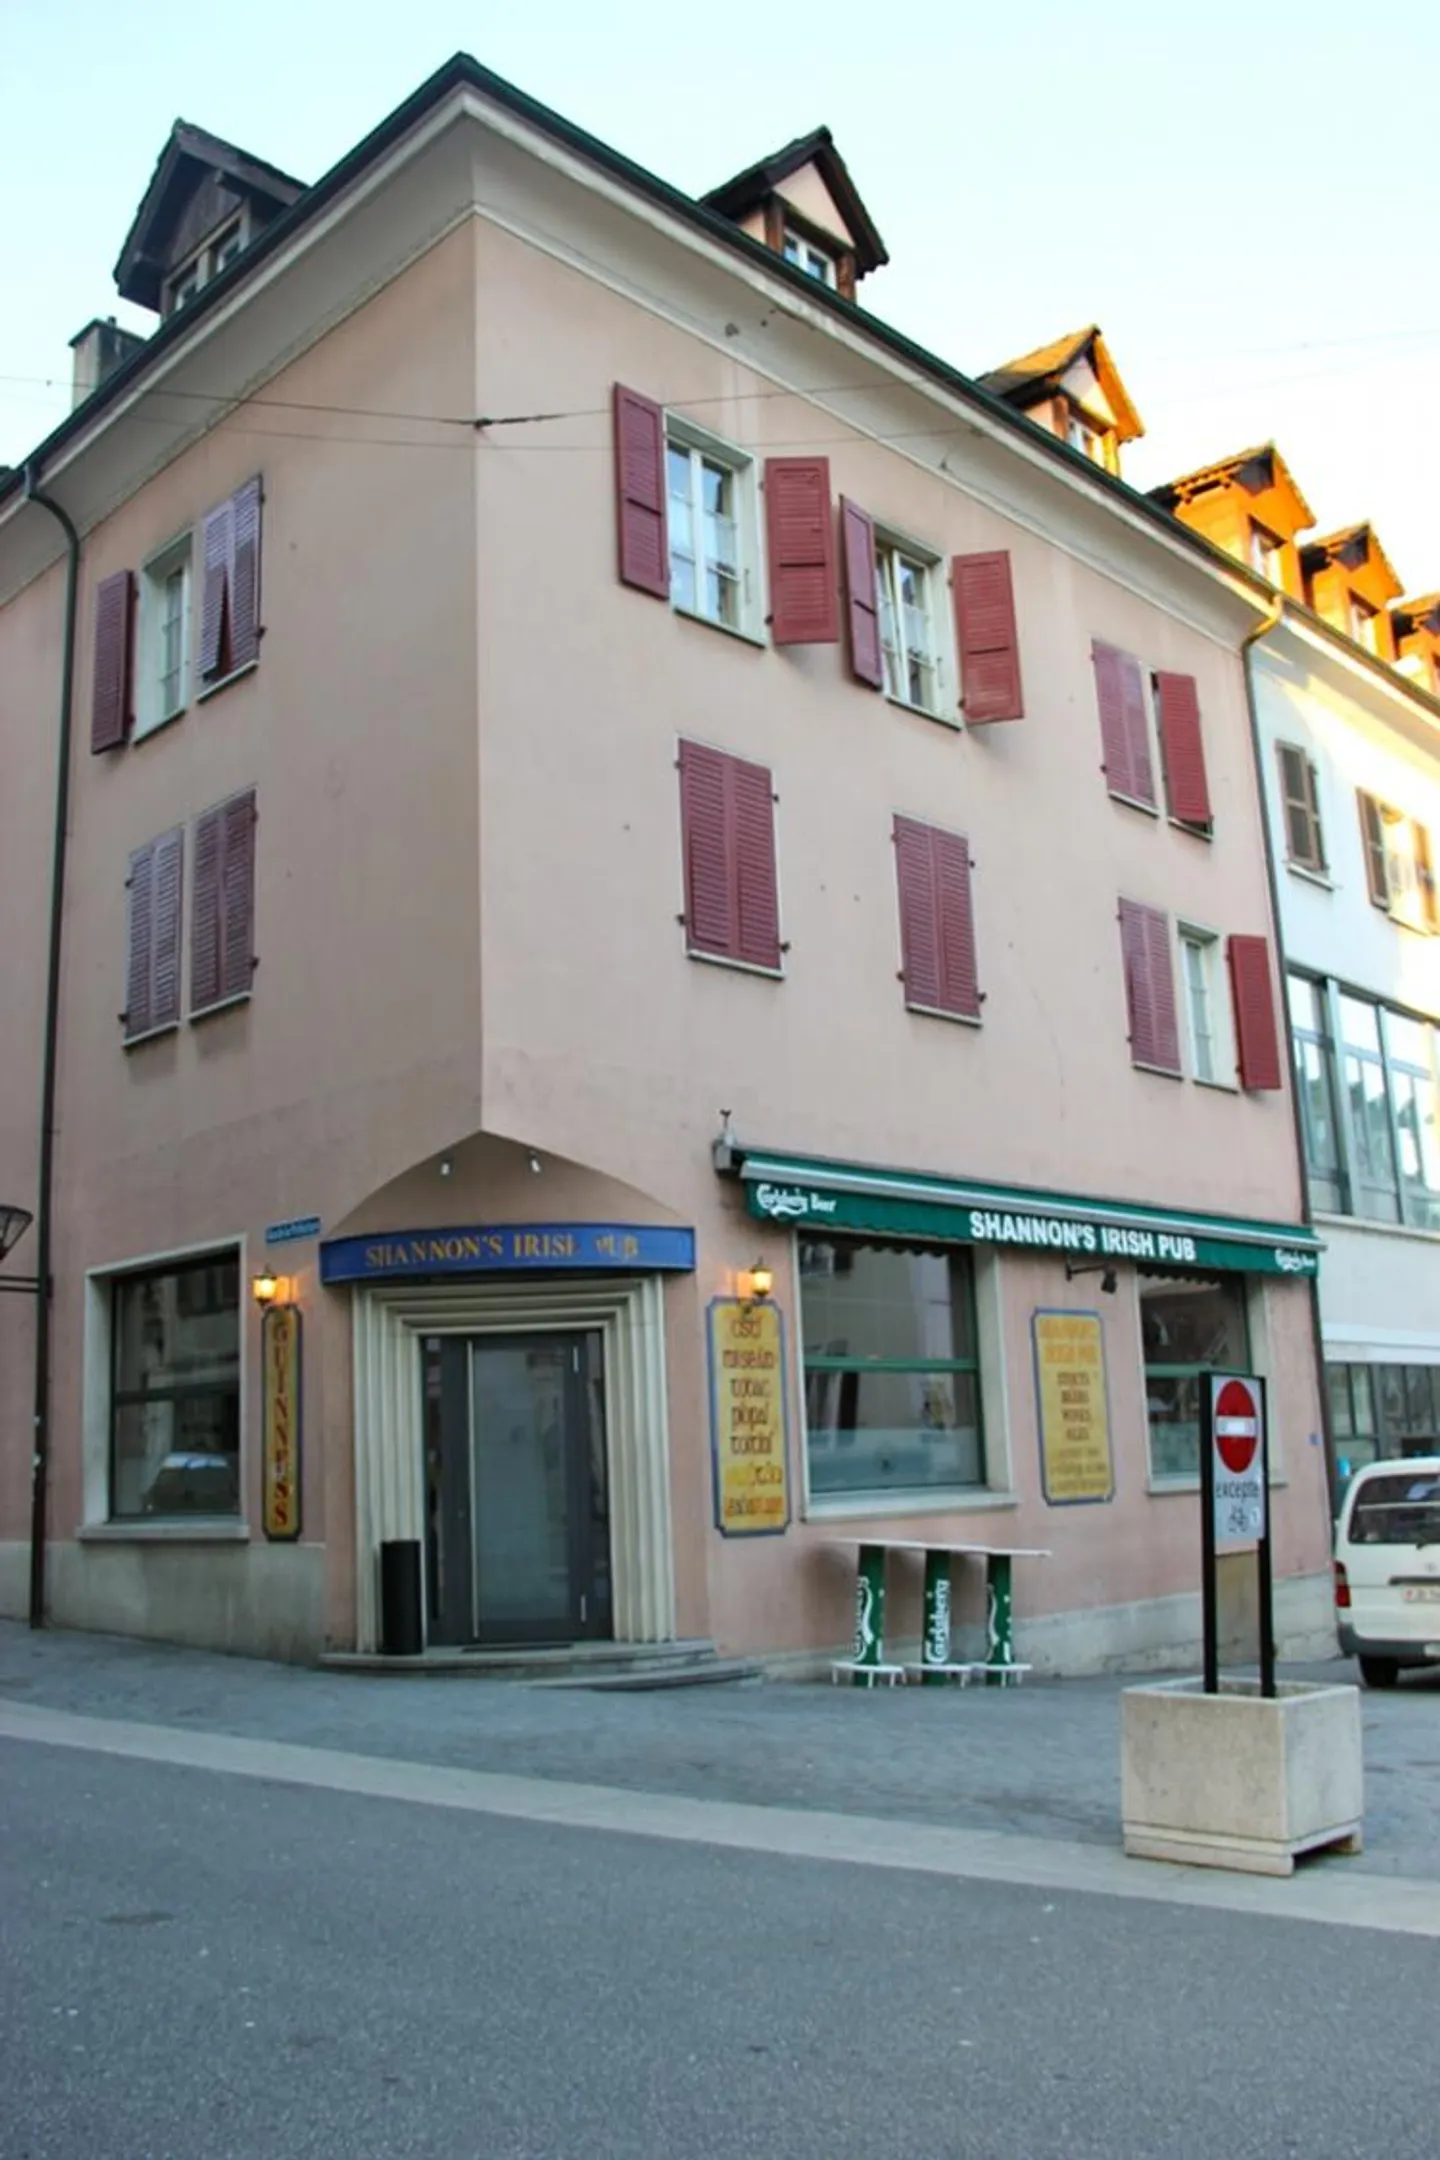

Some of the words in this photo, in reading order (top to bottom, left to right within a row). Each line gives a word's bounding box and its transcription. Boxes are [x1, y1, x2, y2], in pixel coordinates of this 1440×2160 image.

[365, 1234, 503, 1268] SHANNON'S
[969, 1211, 1096, 1251] SHANNON'S
[1101, 1227, 1156, 1257] IRISH
[1158, 1234, 1198, 1262] PUB
